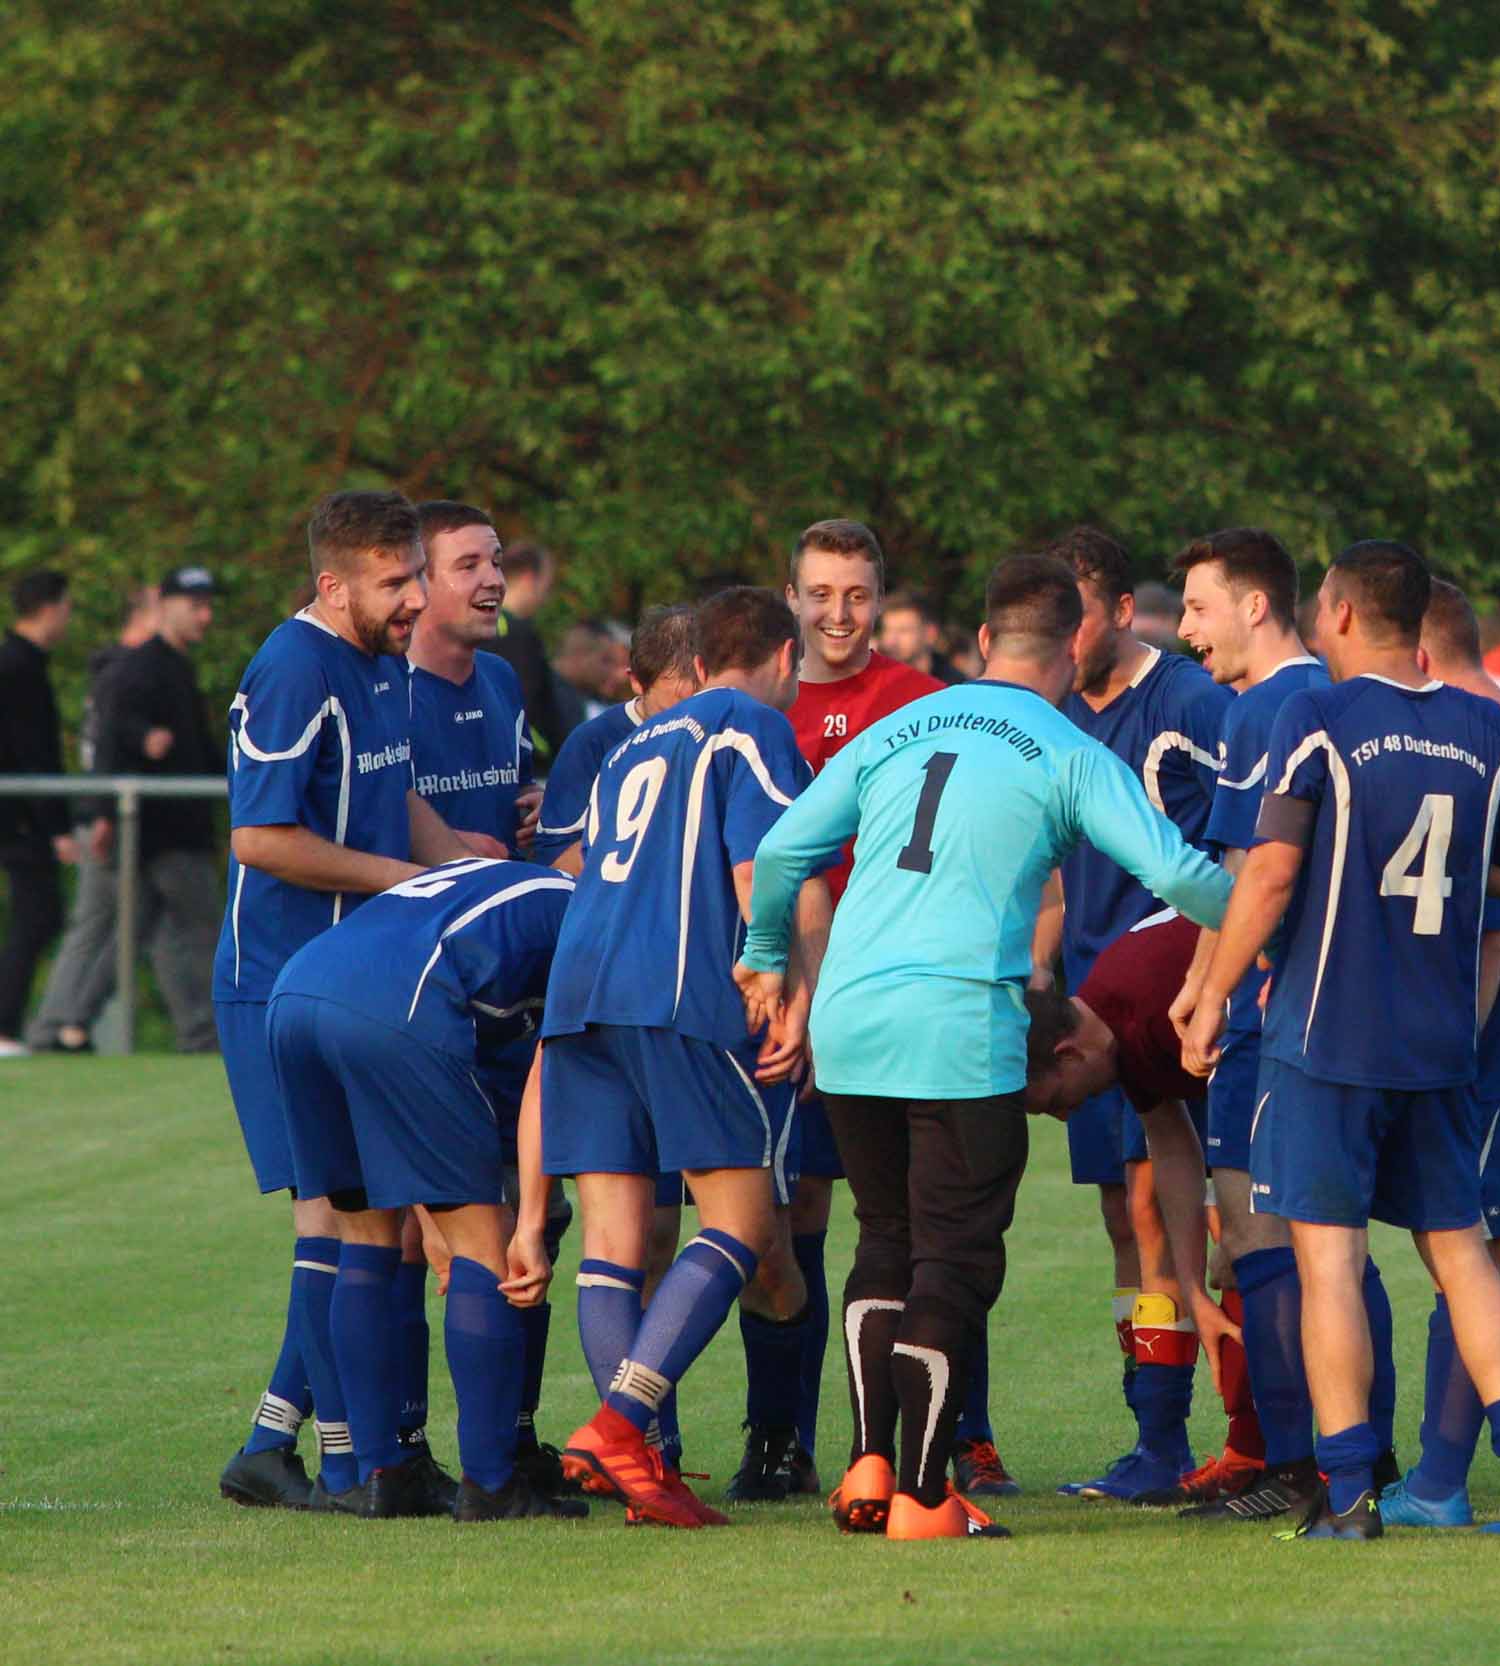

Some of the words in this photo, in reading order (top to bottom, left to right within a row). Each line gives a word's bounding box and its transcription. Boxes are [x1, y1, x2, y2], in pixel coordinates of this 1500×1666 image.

[823, 713, 848, 738] 29
[884, 719, 921, 750] TSV
[927, 711, 1043, 763] Duttenbrunn
[1351, 737, 1380, 768] TSV
[1383, 734, 1402, 753] 48
[600, 755, 668, 883] 9
[896, 750, 960, 875] 1
[1379, 793, 1454, 936] 4
